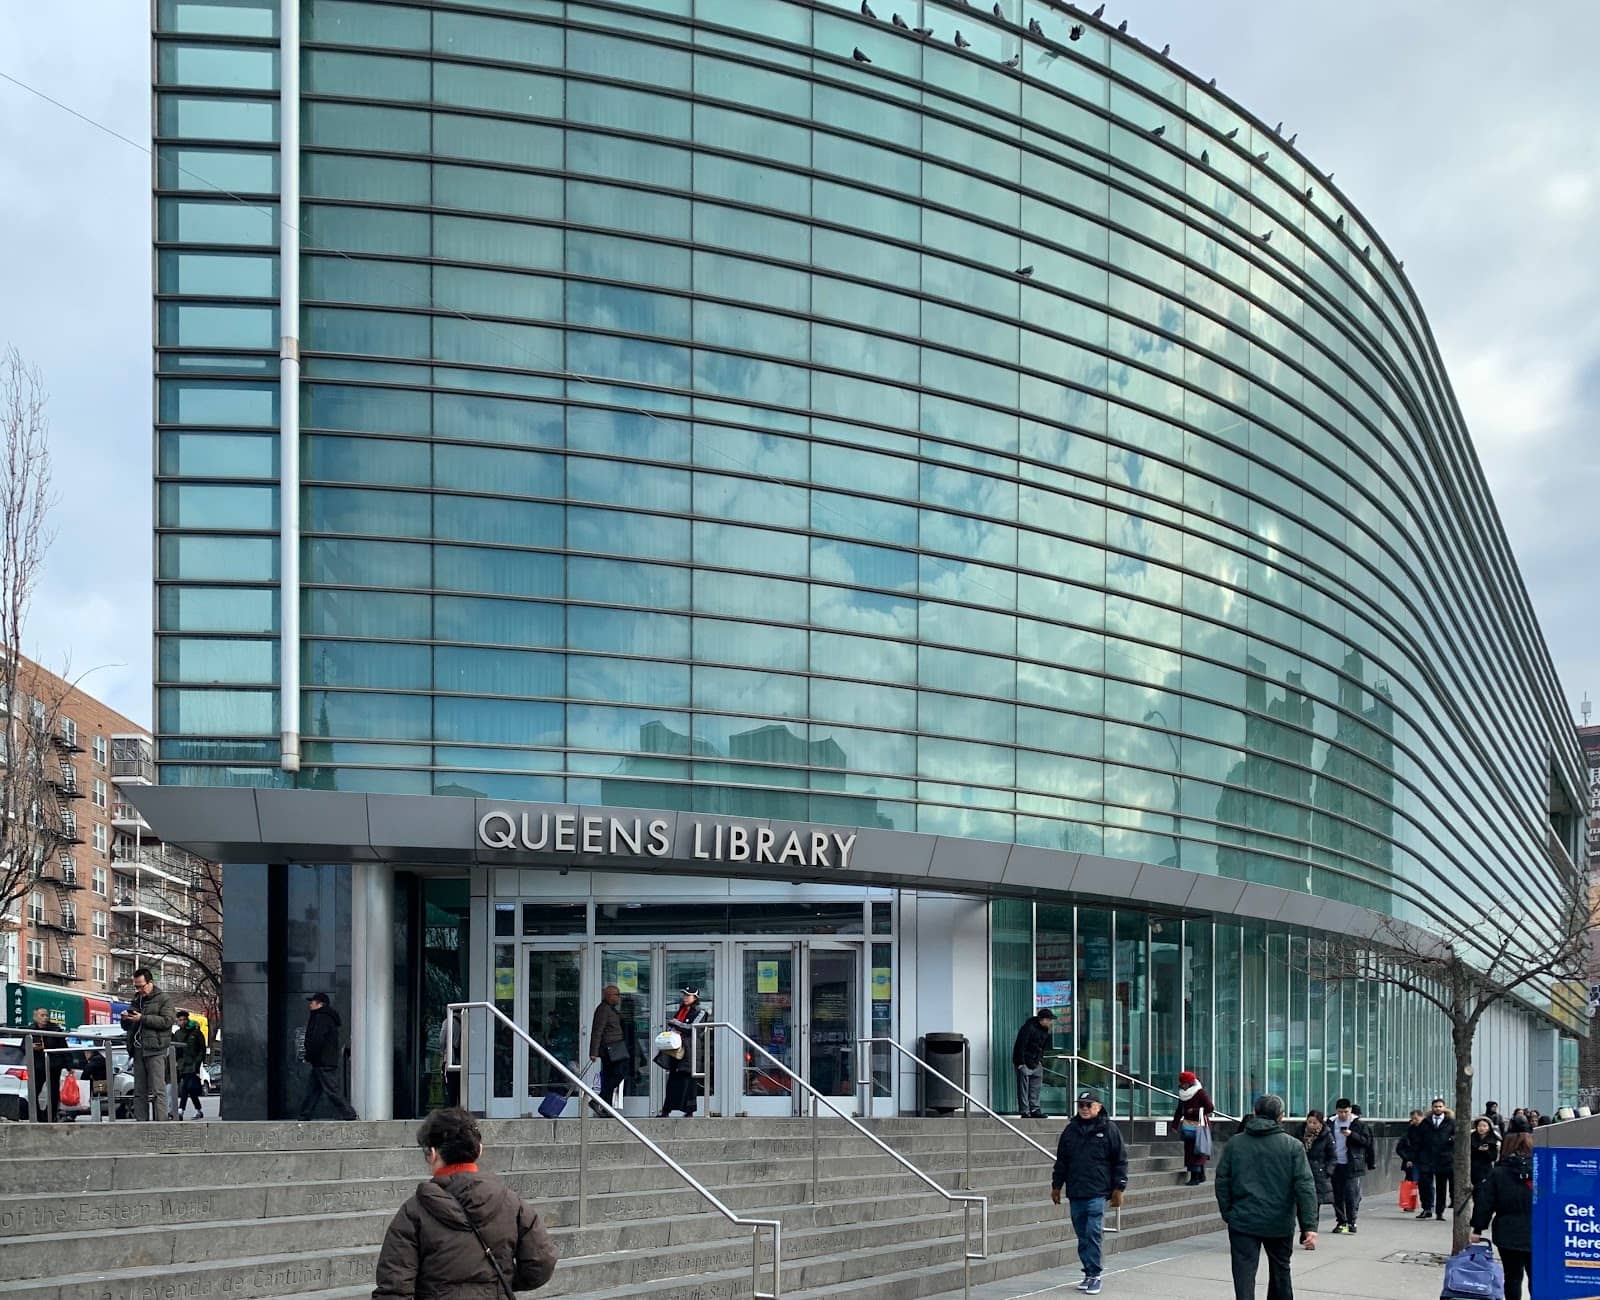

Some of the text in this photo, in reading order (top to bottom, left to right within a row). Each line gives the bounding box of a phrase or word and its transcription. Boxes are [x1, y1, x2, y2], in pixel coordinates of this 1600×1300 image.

[478, 811, 857, 868] QUEENS LIBRARY
[1, 1206, 26, 1229] of
[32, 1207, 67, 1226] the
[78, 1203, 151, 1221] Eastern
[1564, 1203, 1596, 1218] Get
[1564, 1219, 1600, 1234] Tick
[129, 1278, 212, 1300] Leyenda
[222, 1275, 244, 1292] de
[253, 1264, 322, 1288] Cantuña
